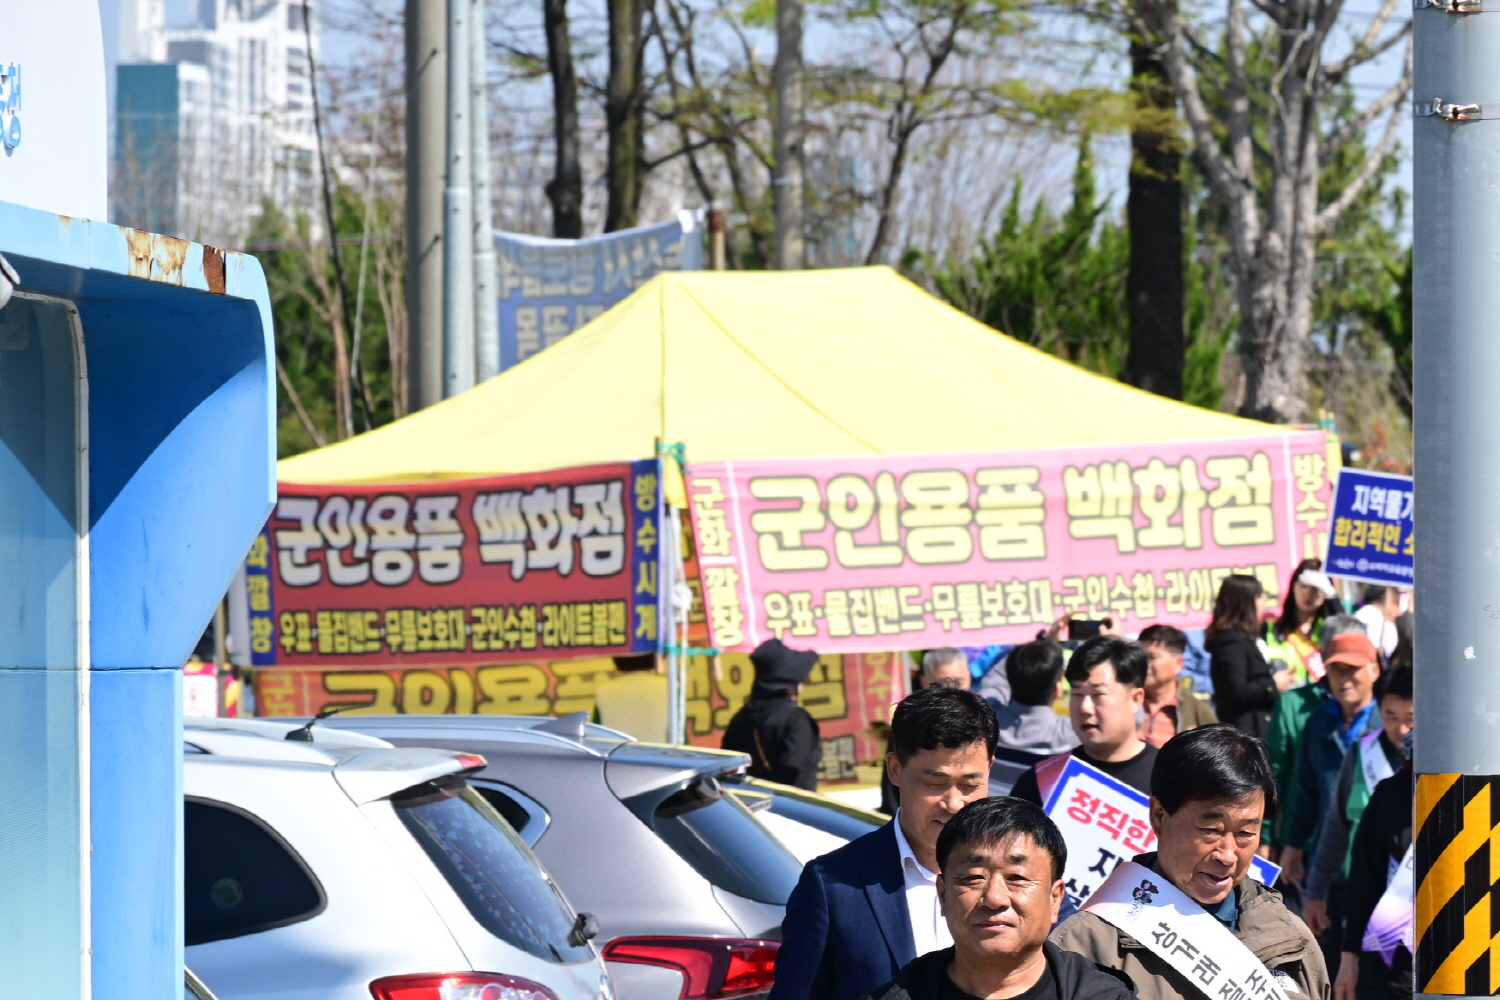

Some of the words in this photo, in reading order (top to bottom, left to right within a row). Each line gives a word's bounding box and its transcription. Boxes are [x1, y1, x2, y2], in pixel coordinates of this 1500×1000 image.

[275, 493, 465, 586] 군인용품
[472, 480, 626, 581] 백화점
[749, 465, 1048, 572] 군인용품
[1062, 452, 1276, 553] 백화점
[1333, 516, 1401, 555] 합리적인
[1067, 787, 1157, 855] 정직한
[1151, 921, 1223, 986] 상거래
